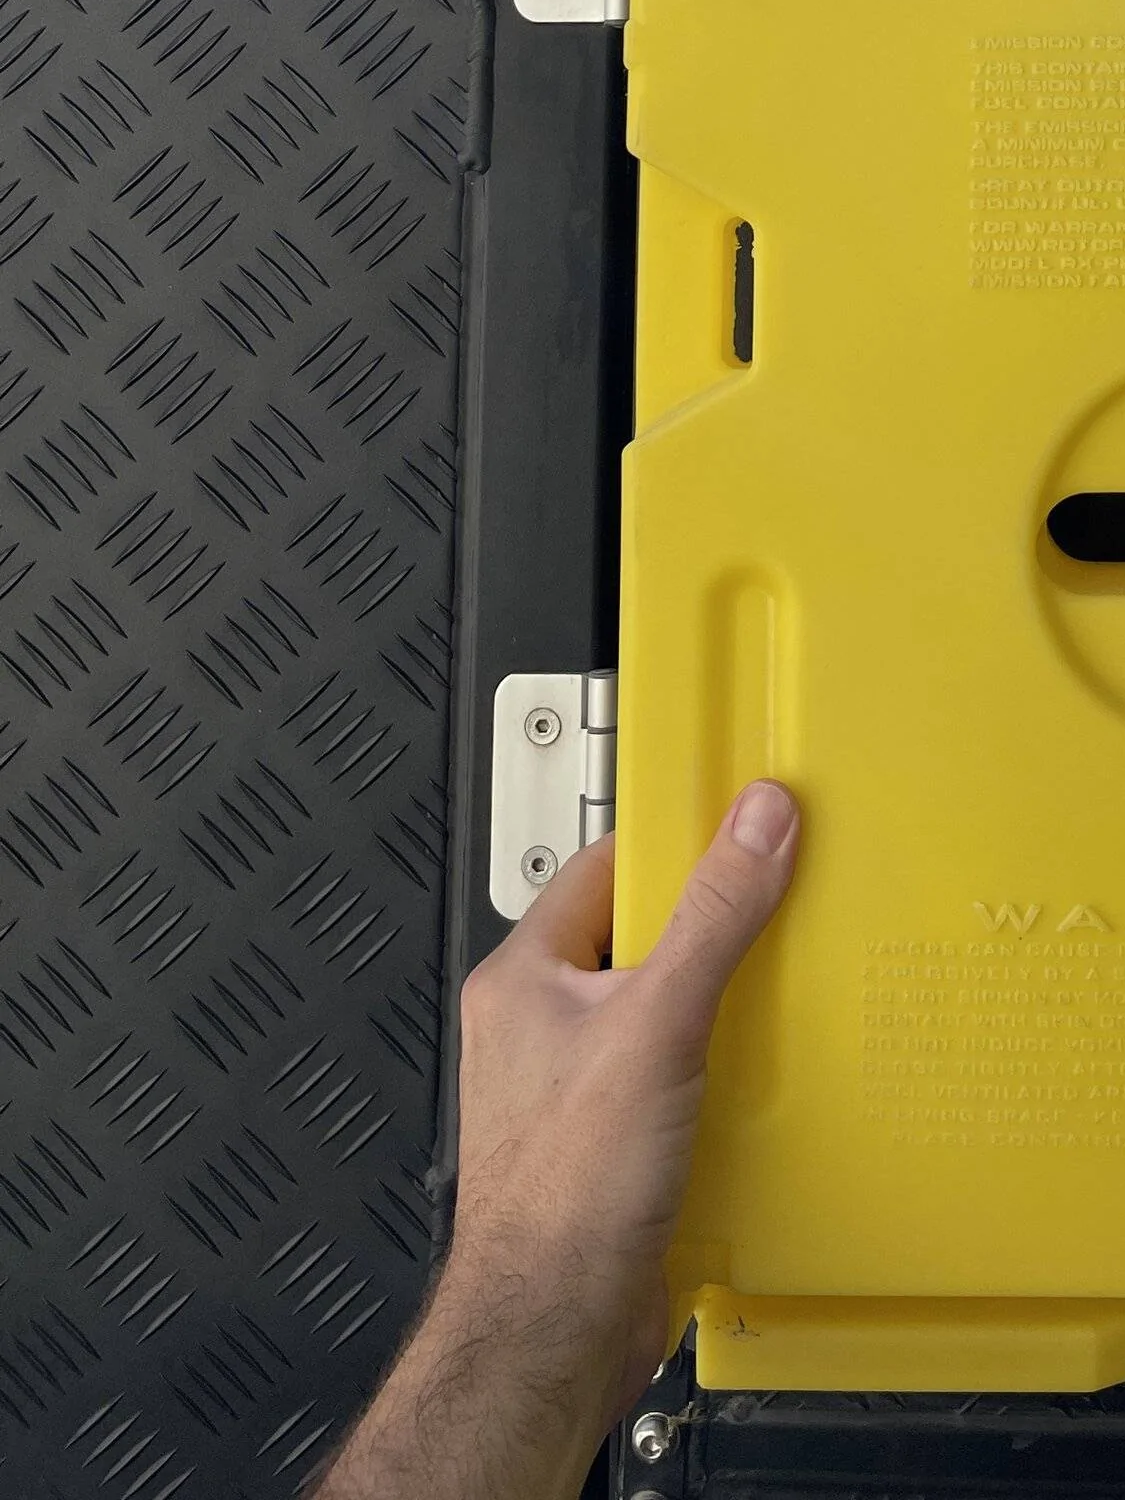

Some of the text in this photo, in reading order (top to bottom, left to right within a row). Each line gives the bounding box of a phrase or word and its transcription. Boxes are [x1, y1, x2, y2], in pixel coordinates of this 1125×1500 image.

[970, 60, 1024, 75] THIS
[970, 96, 1027, 111] FUEL
[971, 120, 1016, 134] THE
[997, 137, 1105, 152] MINIMUM
[969, 220, 1017, 235] FOR
